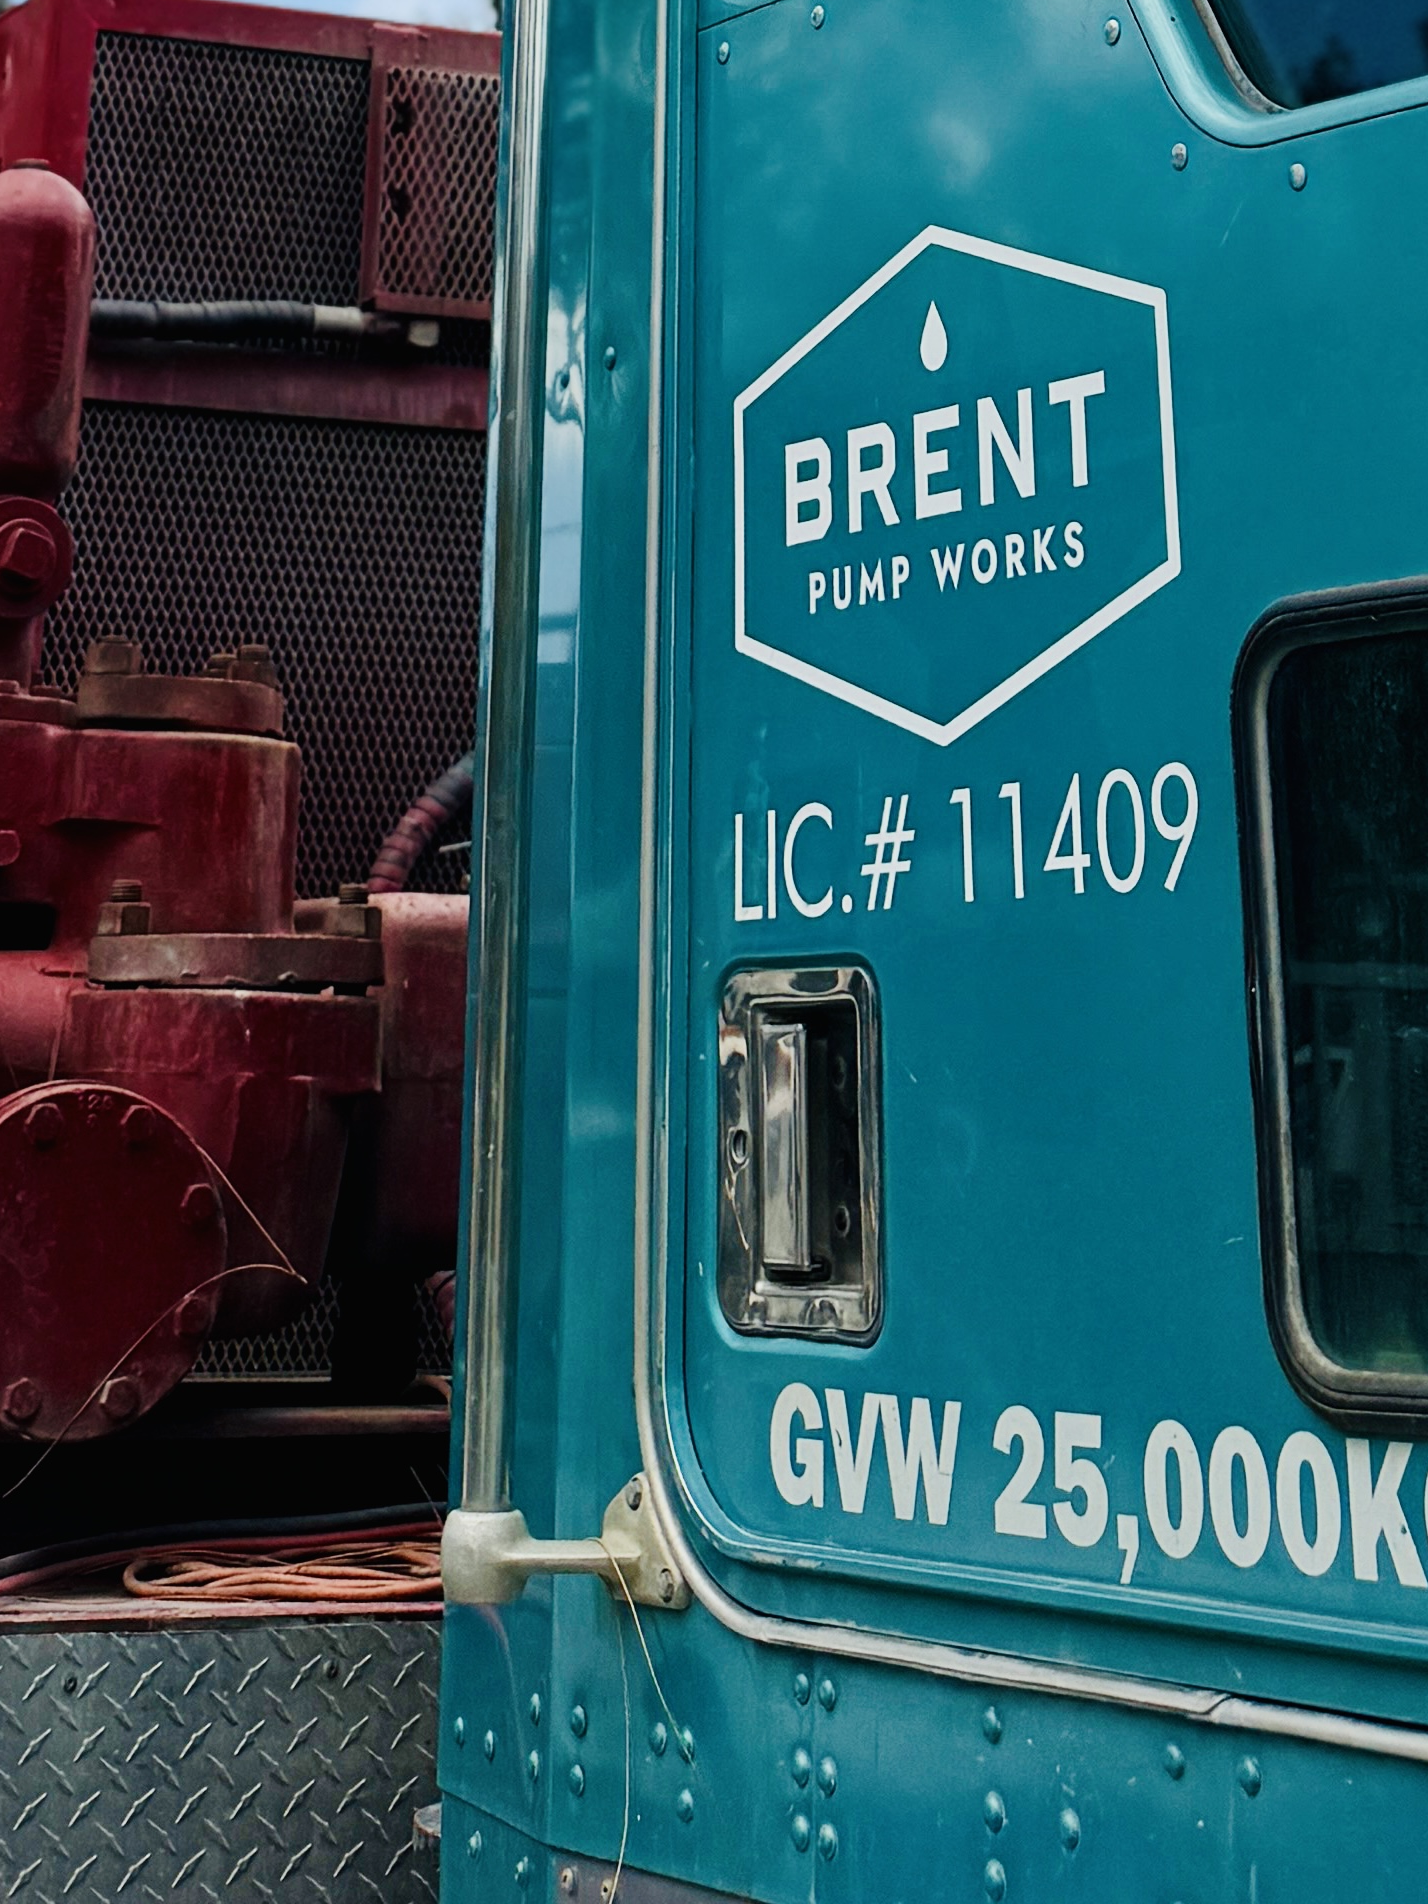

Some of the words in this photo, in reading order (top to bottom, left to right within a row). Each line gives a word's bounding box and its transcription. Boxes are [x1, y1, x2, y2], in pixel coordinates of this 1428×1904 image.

[783, 369, 1107, 548] BRENT
[808, 554, 911, 615] PUMP
[930, 520, 1085, 592] WORKS
[948, 760, 1200, 904] 11409
[769, 1381, 963, 1527] GVW
